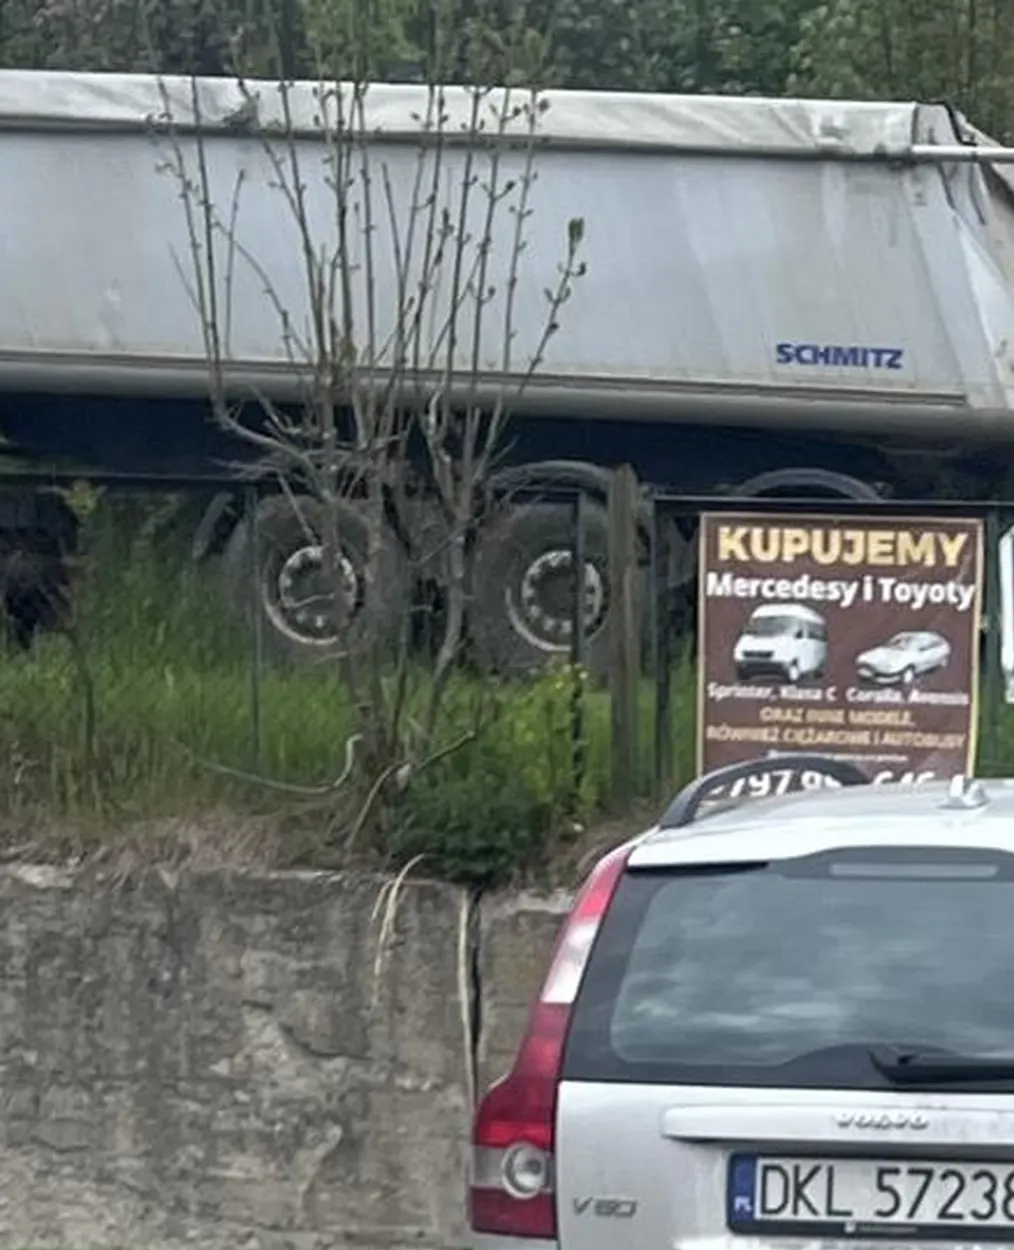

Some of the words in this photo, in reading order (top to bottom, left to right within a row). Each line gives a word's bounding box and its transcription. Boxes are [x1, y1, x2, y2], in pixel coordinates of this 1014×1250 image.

[776, 343, 904, 369] SCHMITZ
[718, 525, 969, 567] KUPUJEMY
[706, 571, 858, 609] Mercedesy
[863, 575, 873, 602] i
[878, 577, 976, 612] Toyoty
[830, 1111, 930, 1131] VOLVO
[760, 1164, 853, 1216] DKL
